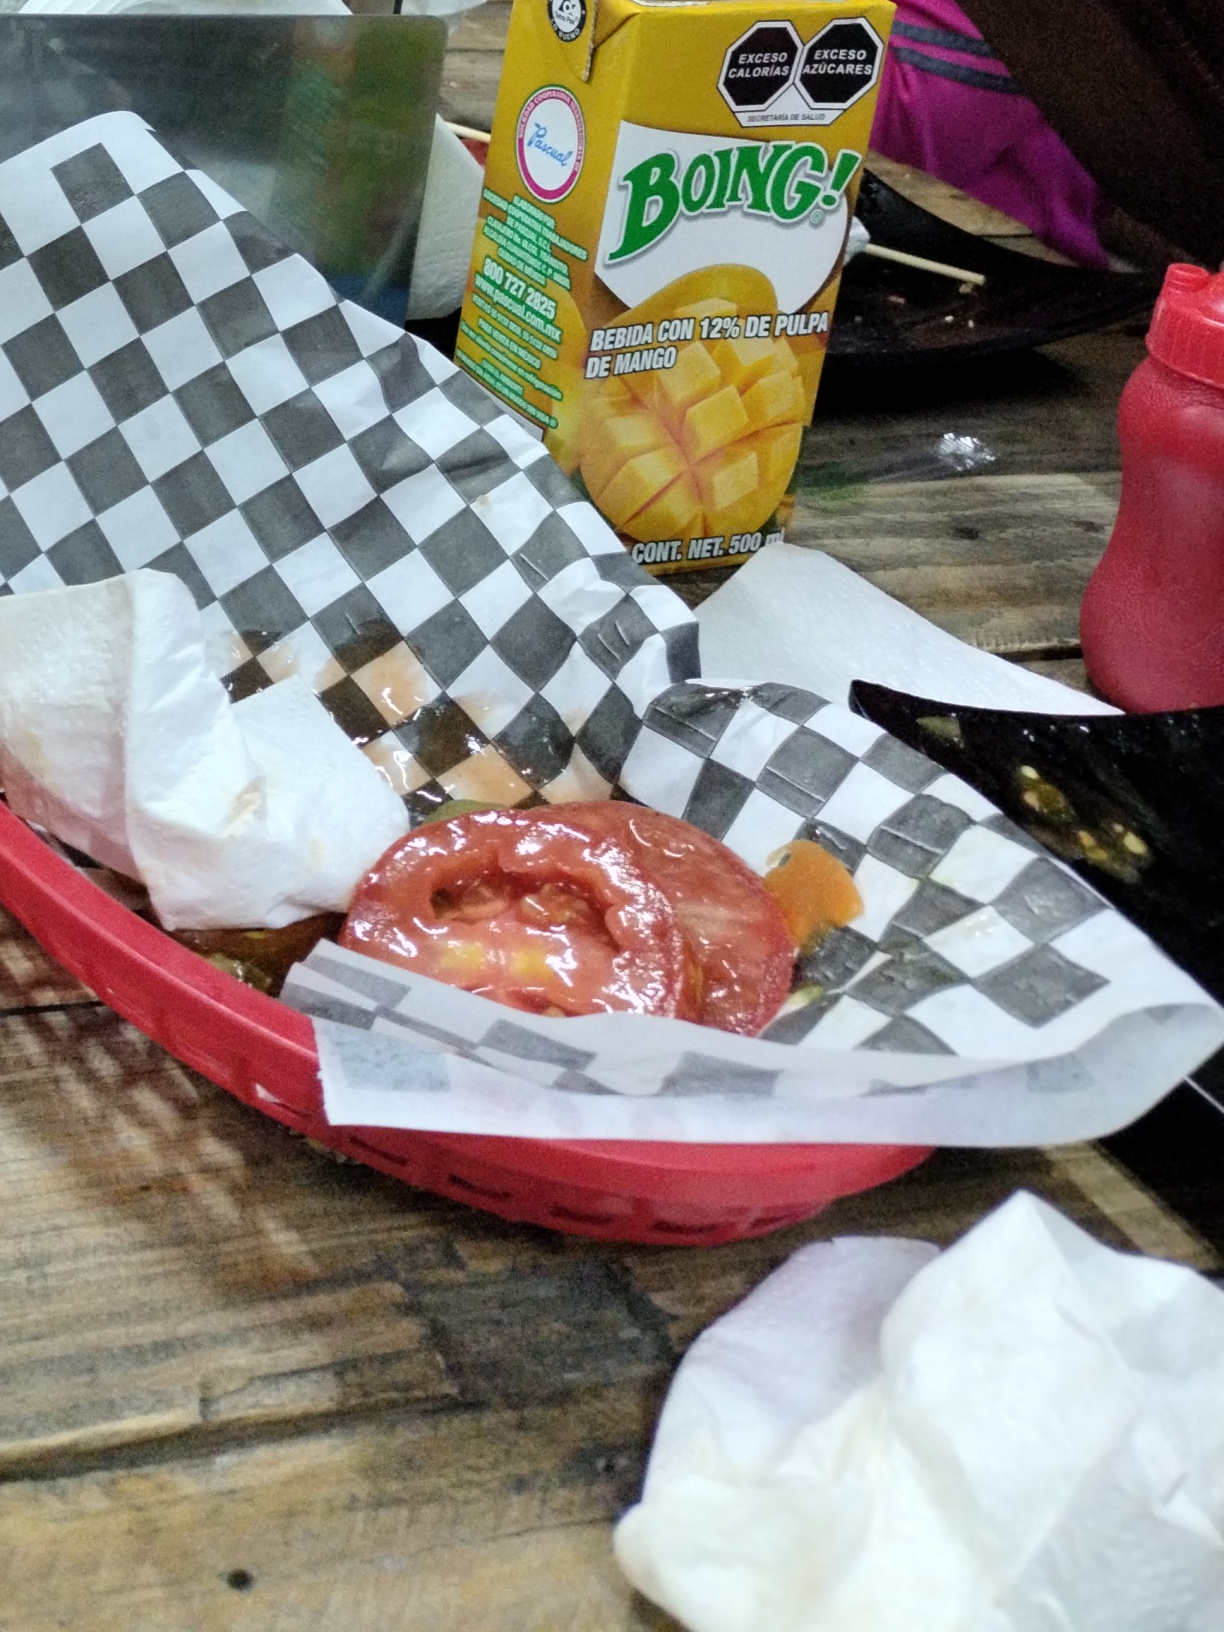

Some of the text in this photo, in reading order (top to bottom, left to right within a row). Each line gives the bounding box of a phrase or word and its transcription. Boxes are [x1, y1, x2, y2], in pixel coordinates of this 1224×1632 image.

[738, 52, 789, 65] EXCESO
[801, 59, 873, 76] AZÚCARES
[813, 49, 868, 62] EXCESO
[727, 63, 790, 79] CALORÍAS
[800, 112, 827, 122] SALUD
[527, 122, 574, 167] Pascual
[608, 147, 863, 264] BOING!
[591, 311, 829, 352] BEBIDA CON 12% DE PULPA
[584, 348, 678, 379] DE MANGO
[631, 539, 683, 564] CONT.
[687, 536, 725, 560] NET.
[728, 531, 762, 555] 500
